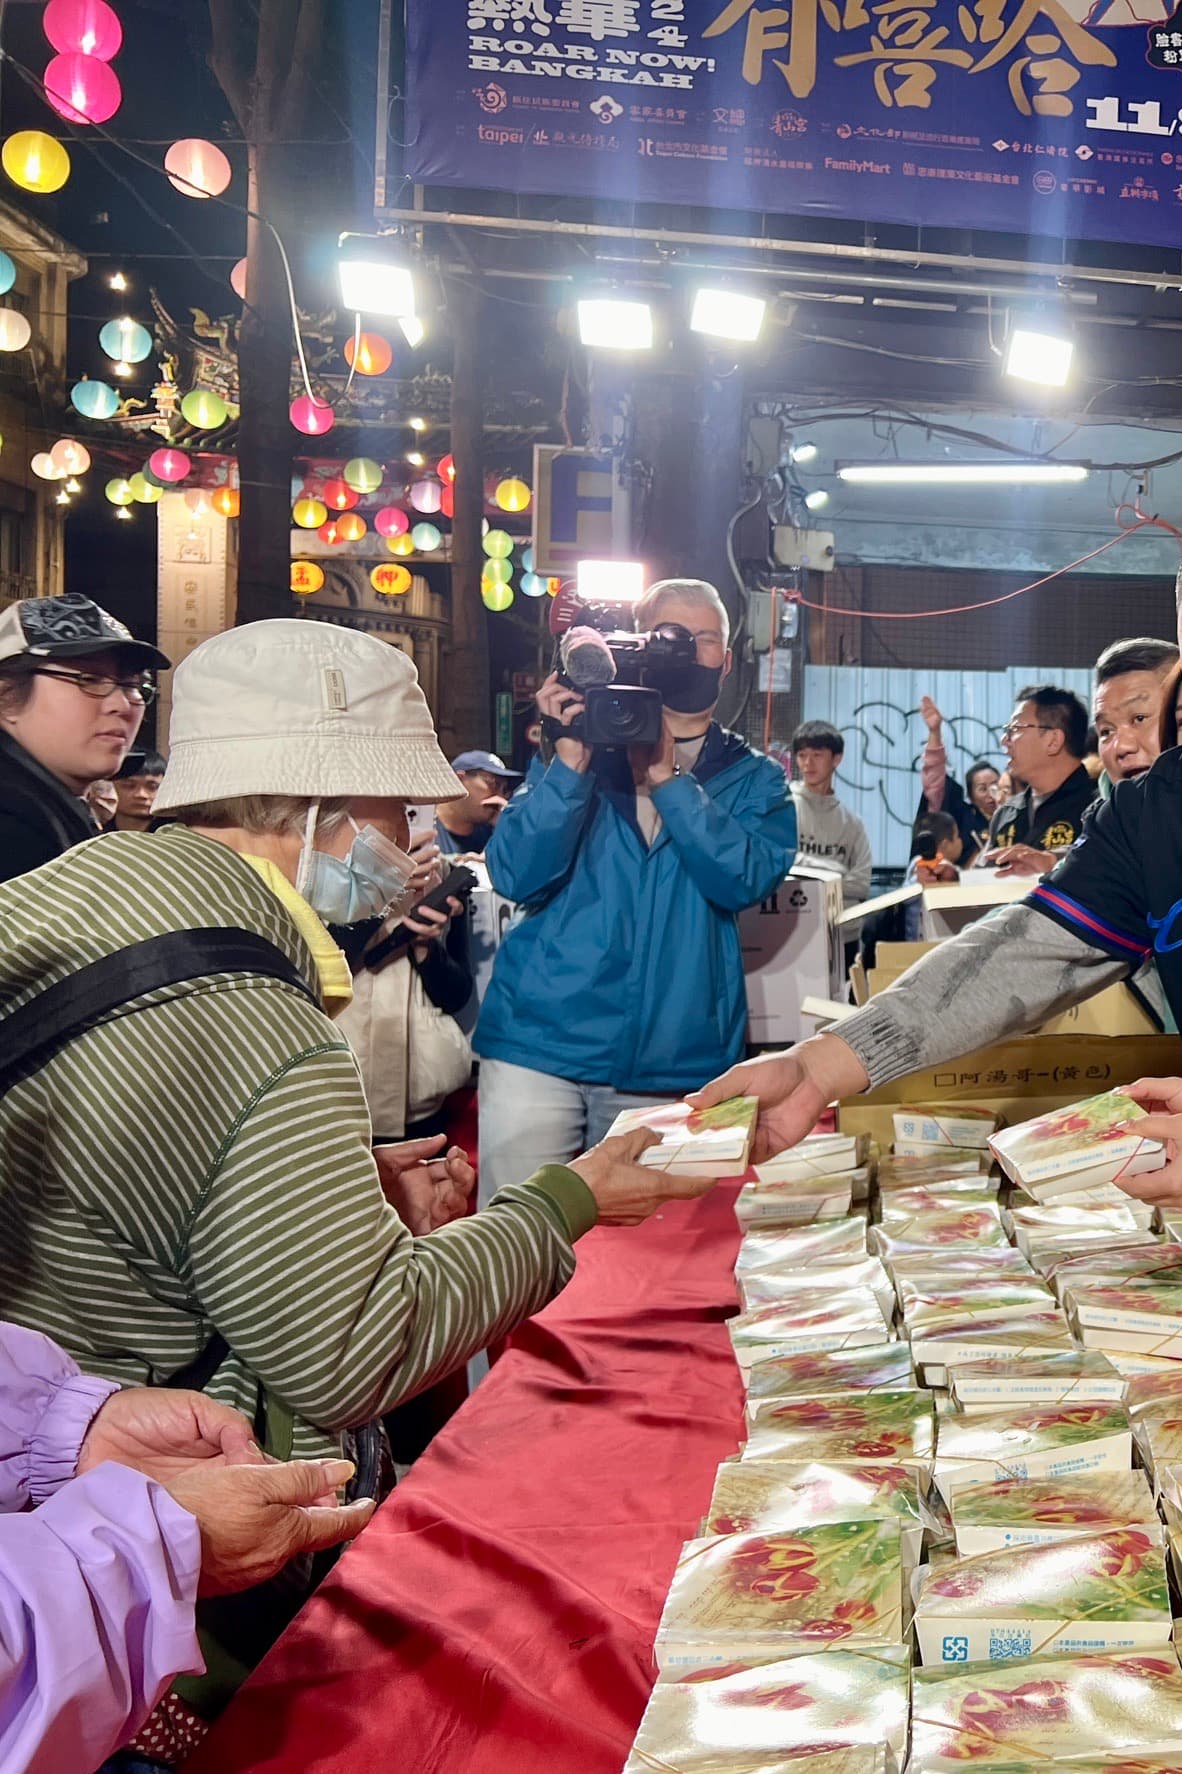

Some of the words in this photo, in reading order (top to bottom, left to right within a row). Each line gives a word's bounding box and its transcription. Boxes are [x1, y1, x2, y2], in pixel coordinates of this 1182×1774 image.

[468, 35, 599, 61] ROAR
[606, 48, 717, 73] NOW!
[468, 55, 694, 89] BANGKAH
[477, 123, 525, 145] taipei
[824, 157, 892, 175] FamilyMart
